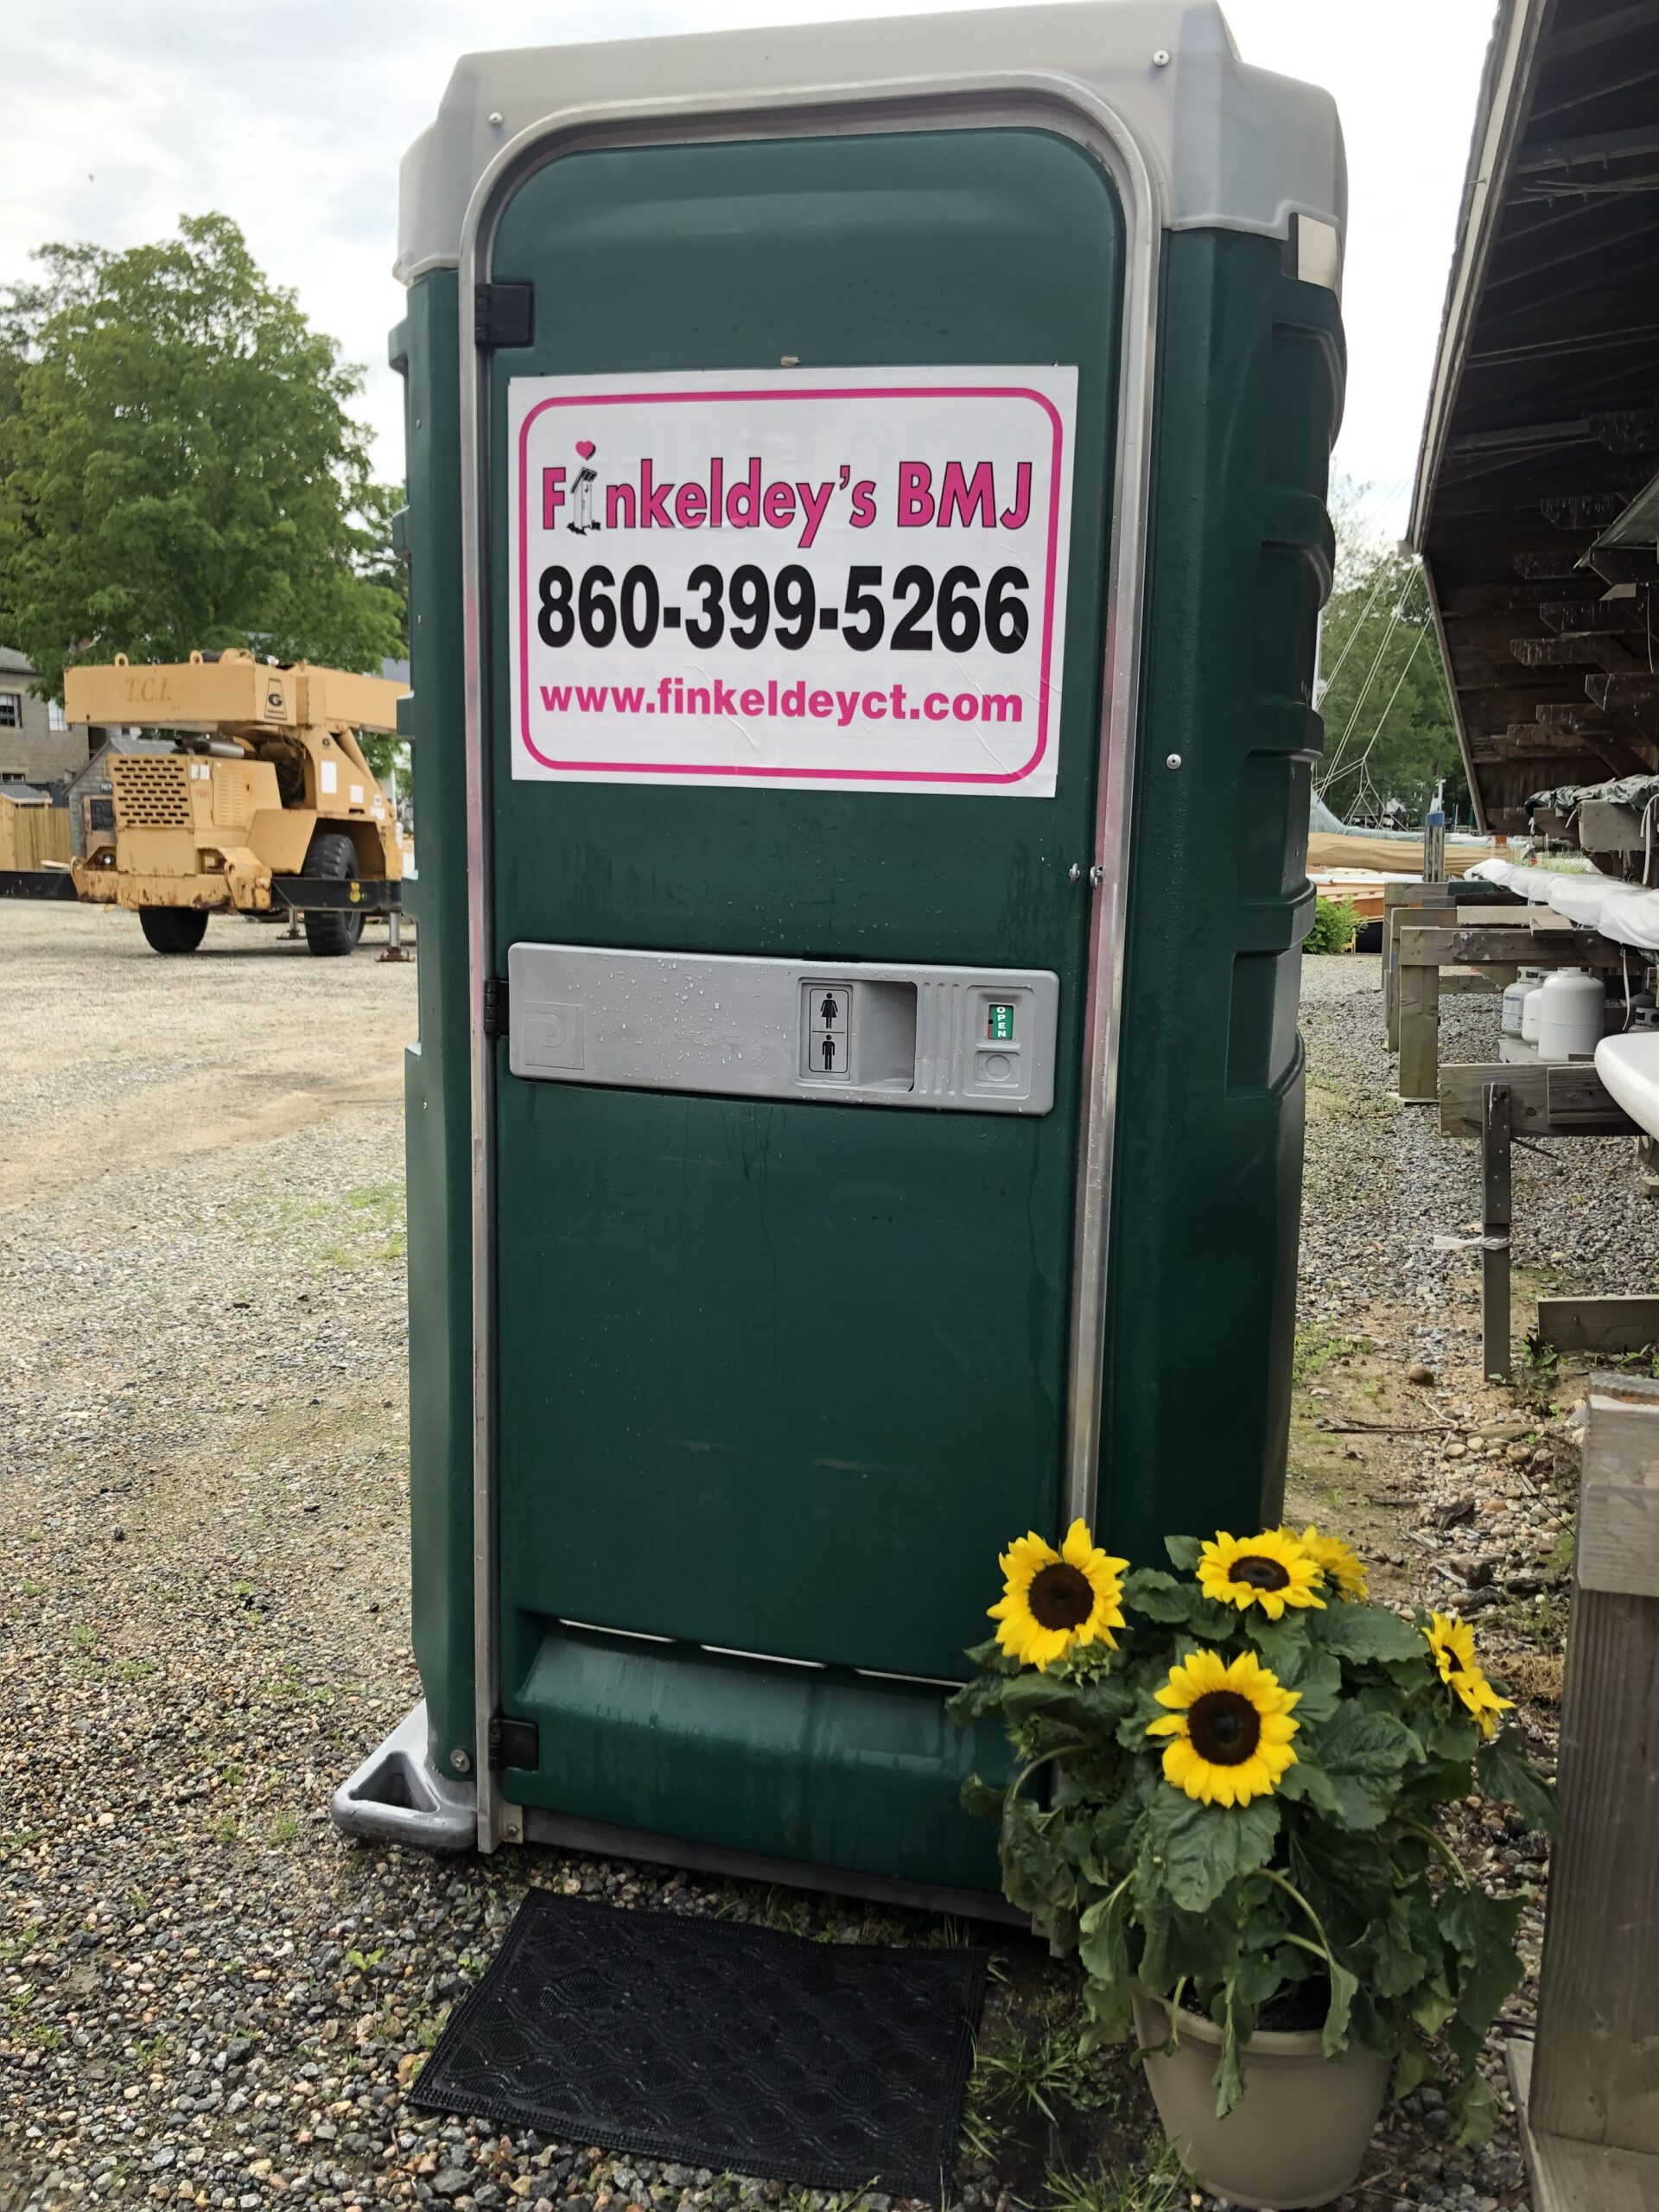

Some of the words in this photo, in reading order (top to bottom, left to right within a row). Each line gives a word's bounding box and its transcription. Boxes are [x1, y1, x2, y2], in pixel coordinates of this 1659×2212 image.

[897, 461, 1033, 531] BMJ
[537, 563, 1030, 655] 860-399-5266
[539, 677, 1023, 727] www.finkeldeyct.com
[996, 1006, 1007, 1038] OPEN
